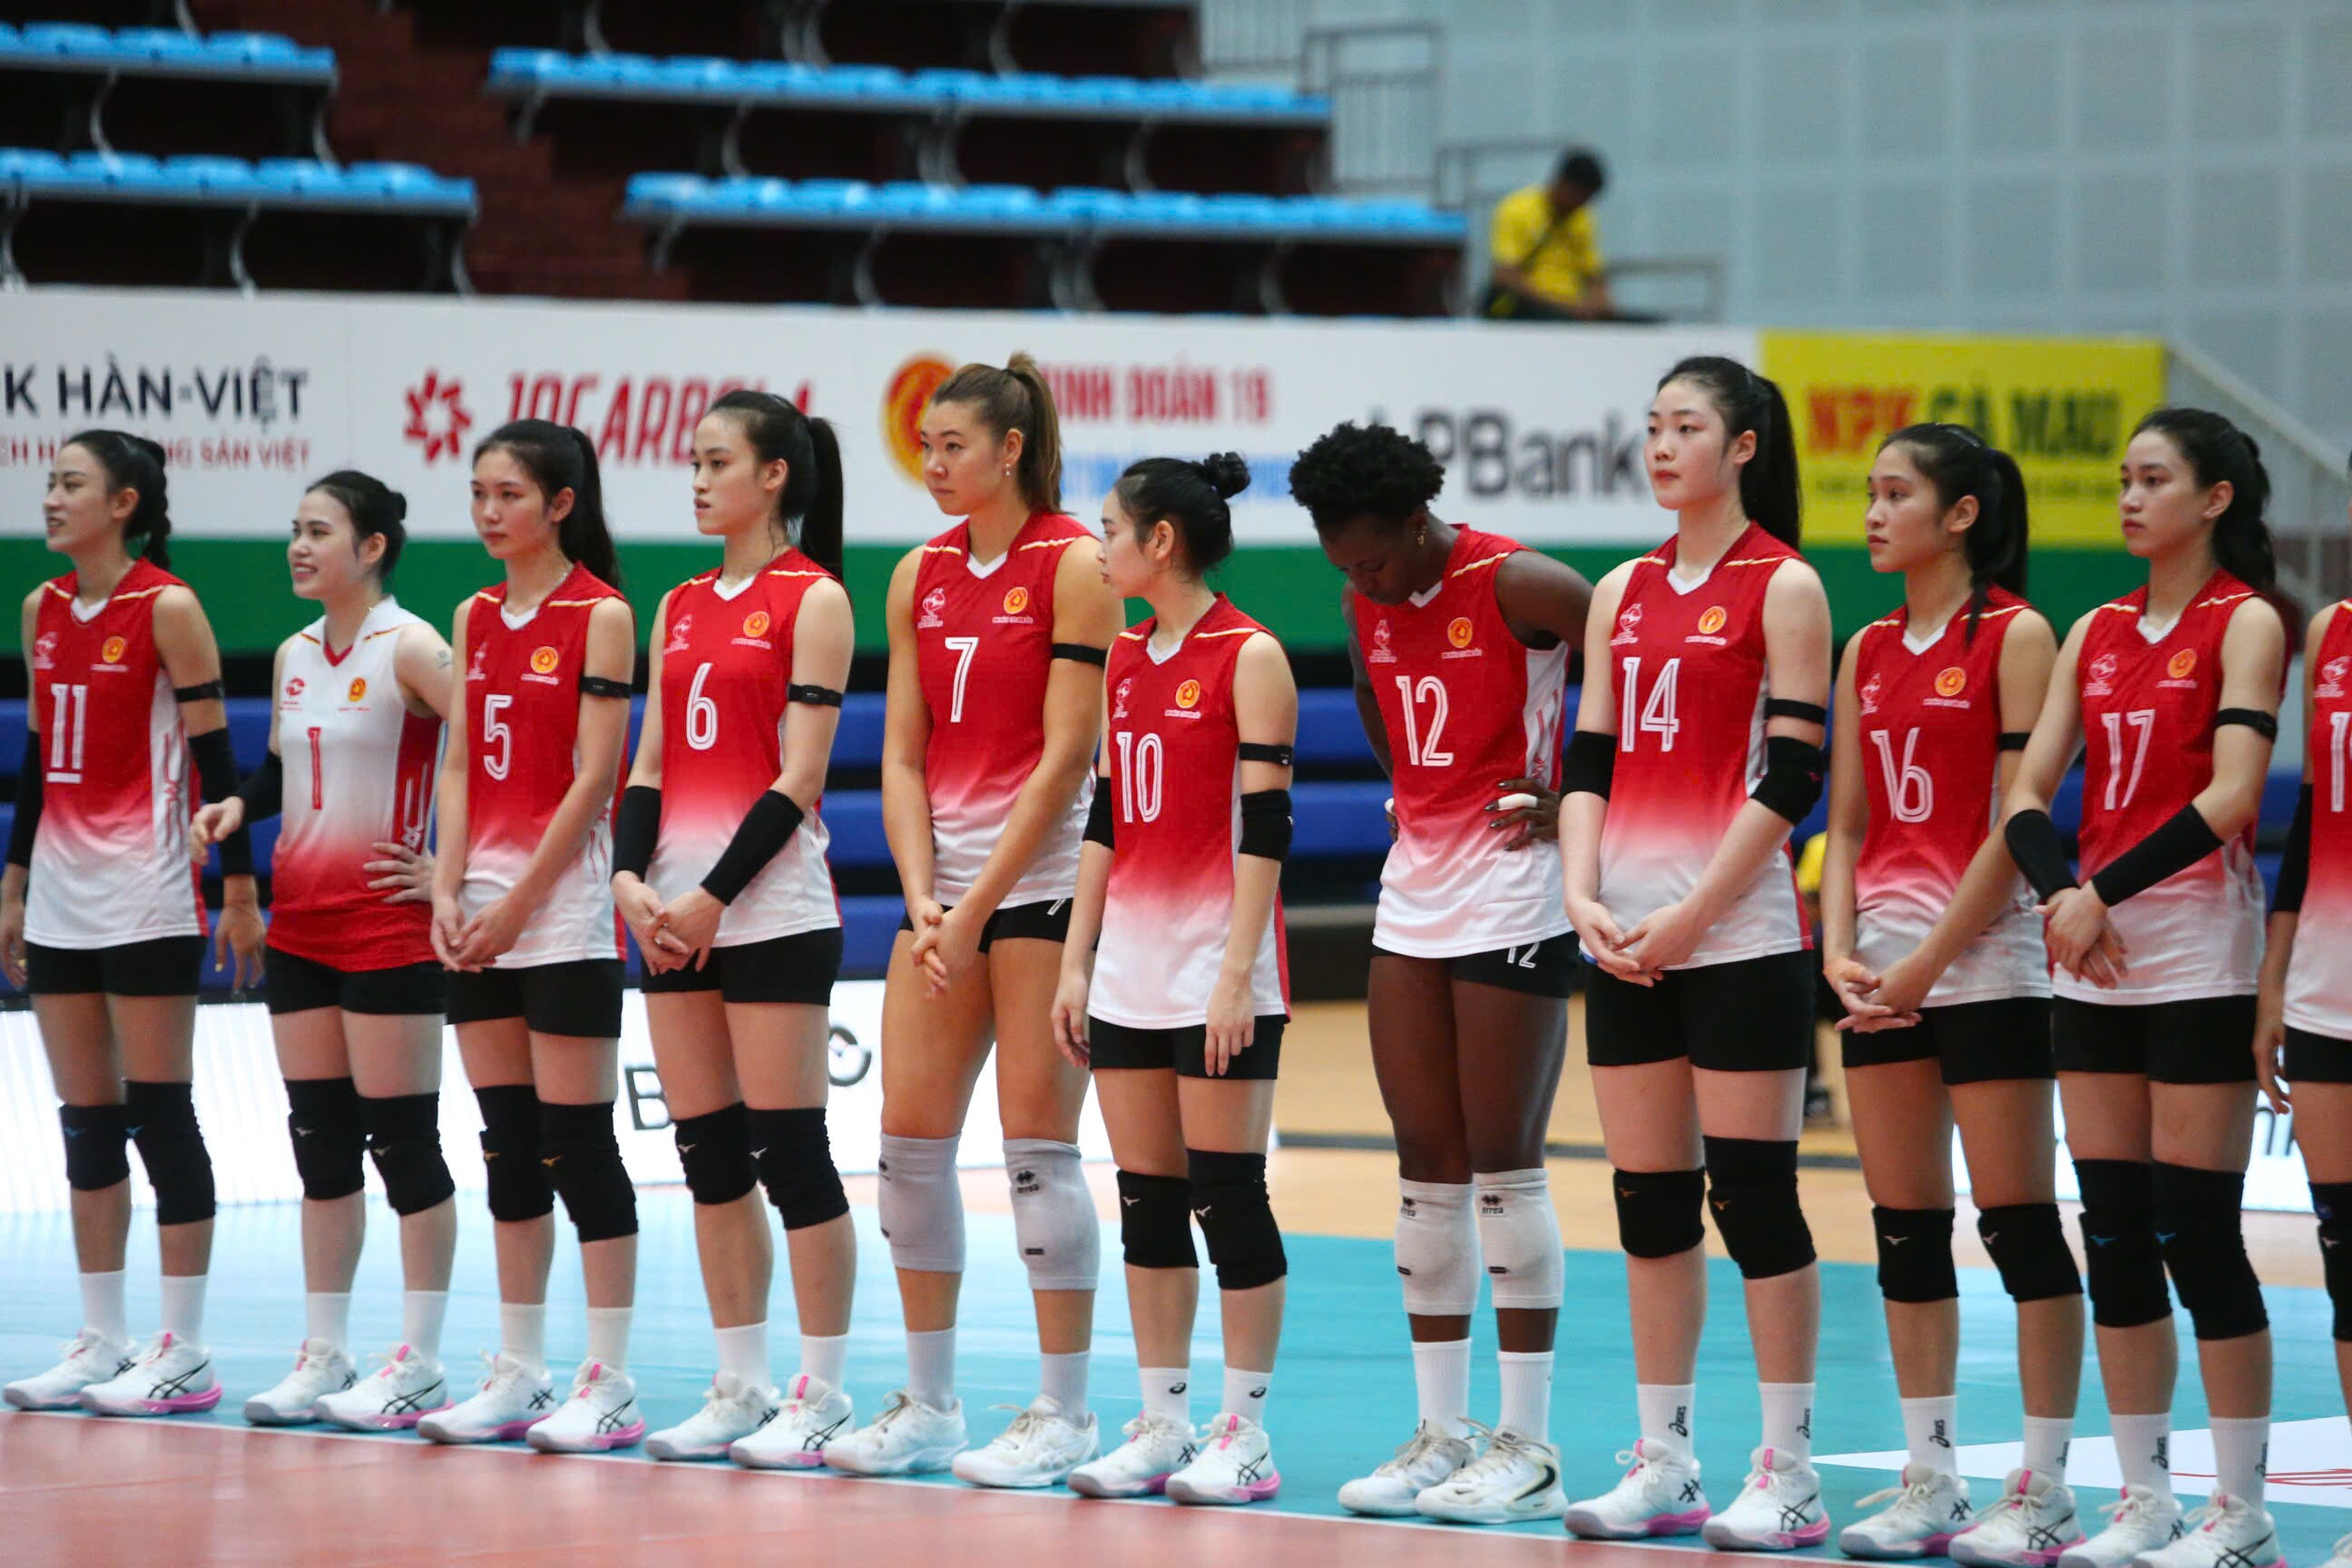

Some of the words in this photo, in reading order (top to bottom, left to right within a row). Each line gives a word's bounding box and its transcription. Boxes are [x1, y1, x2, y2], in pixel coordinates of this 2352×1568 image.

[506, 371, 814, 465] JOCARB
[1042, 363, 1114, 421] INH
[1367, 407, 1650, 501] PBank
[50, 682, 87, 770] 11
[686, 662, 718, 751] 6
[945, 636, 979, 723] 7
[1394, 674, 1454, 768] 12
[1621, 656, 1681, 753] 14
[307, 727, 323, 810] 1
[484, 693, 513, 781] 5
[1116, 730, 1163, 824] 10
[1869, 726, 1935, 823] 16
[2101, 708, 2156, 811] 17
[2330, 710, 2352, 813] 1
